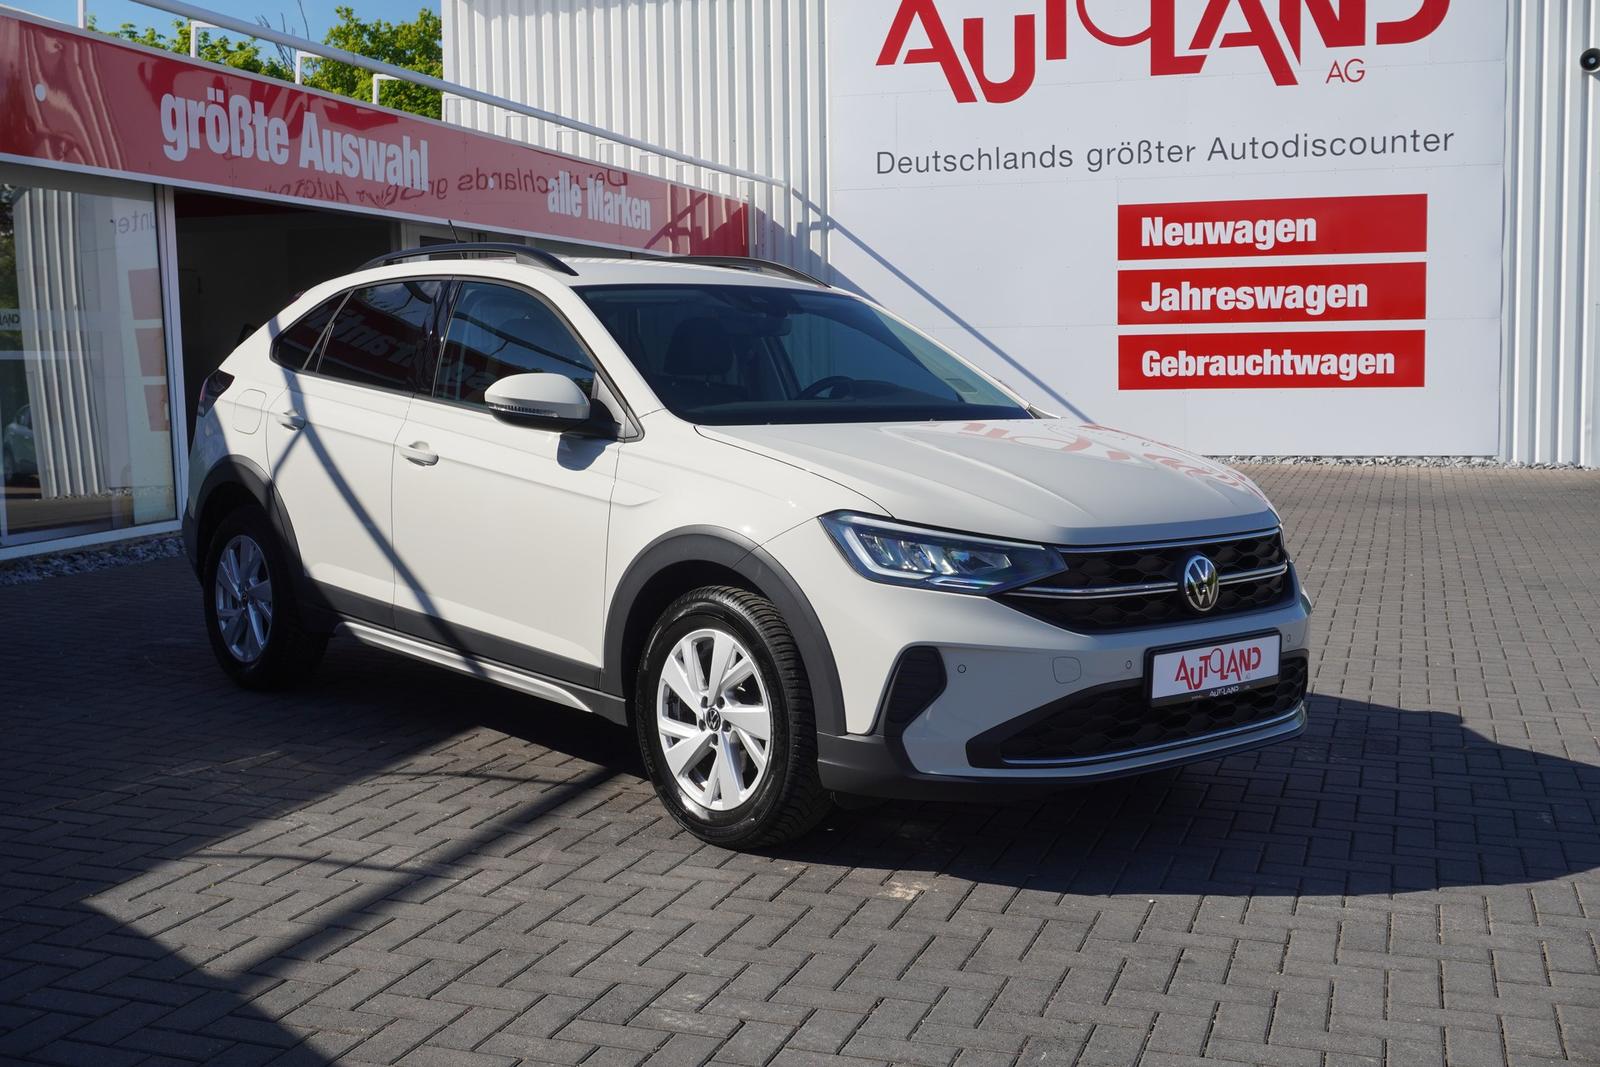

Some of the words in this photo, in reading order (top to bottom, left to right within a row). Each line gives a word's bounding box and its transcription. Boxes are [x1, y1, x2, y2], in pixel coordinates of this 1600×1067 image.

[1326, 58, 1366, 84] AG
[161, 86, 290, 165] größte
[300, 112, 429, 191] Auswahl
[876, 145, 1074, 175] Deutschlands
[1087, 139, 1197, 174] größter
[1207, 128, 1455, 162] Autodiscounter
[547, 170, 582, 218] alle
[588, 177, 651, 231] Marken
[1141, 216, 1317, 250] Neuwagen
[1141, 281, 1368, 316] Jahreswagen
[1142, 348, 1395, 382] Gebrauchtwagen
[1175, 647, 1261, 690] AUTOLAND
